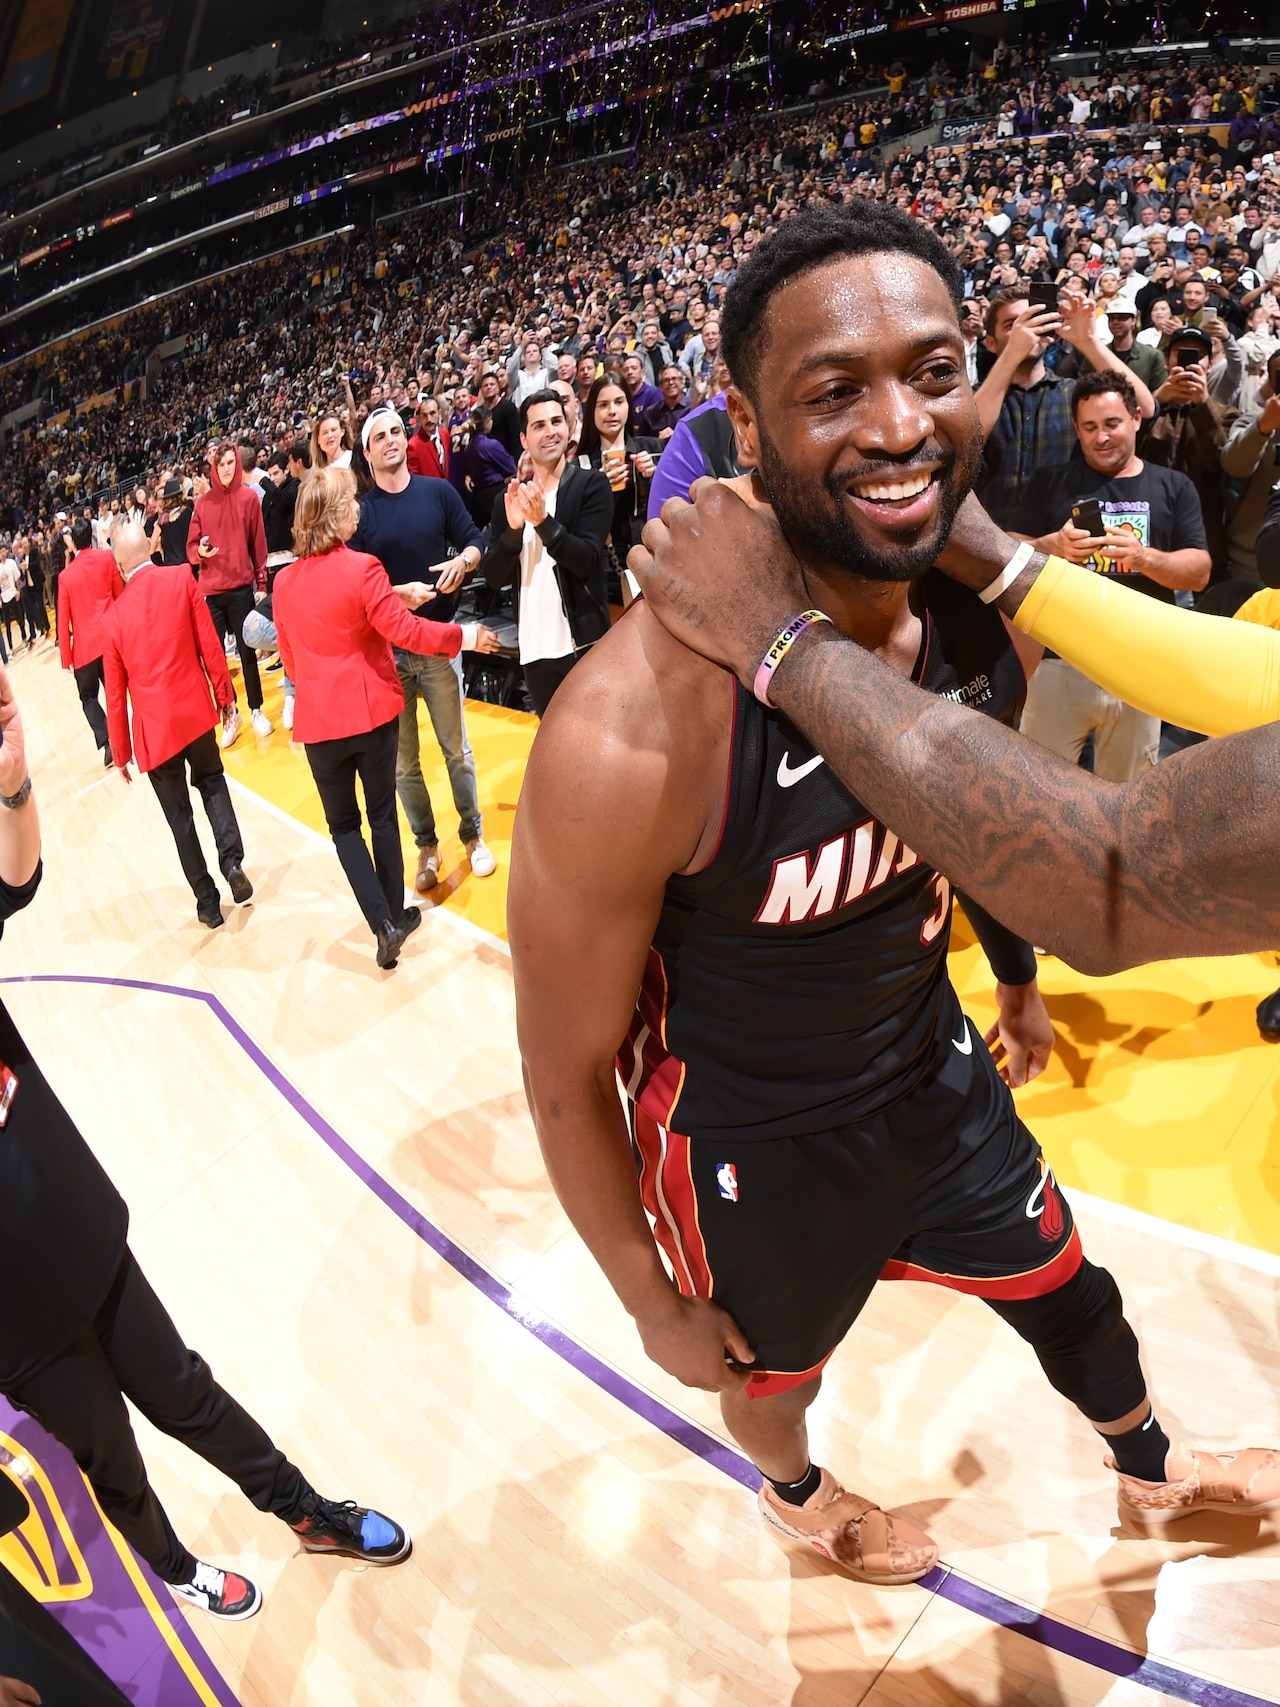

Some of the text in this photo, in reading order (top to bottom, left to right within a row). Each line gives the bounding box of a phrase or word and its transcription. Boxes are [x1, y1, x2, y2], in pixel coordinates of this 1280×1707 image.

[945, 2, 997, 20] TOSHIBA
[732, 54, 770, 73] Spectrum
[289, 110, 401, 157] LAKERS
[483, 126, 523, 144] TOYOTA
[170, 181, 202, 200] Spectrum
[254, 199, 289, 221] STAPLES
[764, 610, 820, 669] I PROMISE
[939, 674, 990, 704] ltimate
[752, 816, 925, 926] MIA
